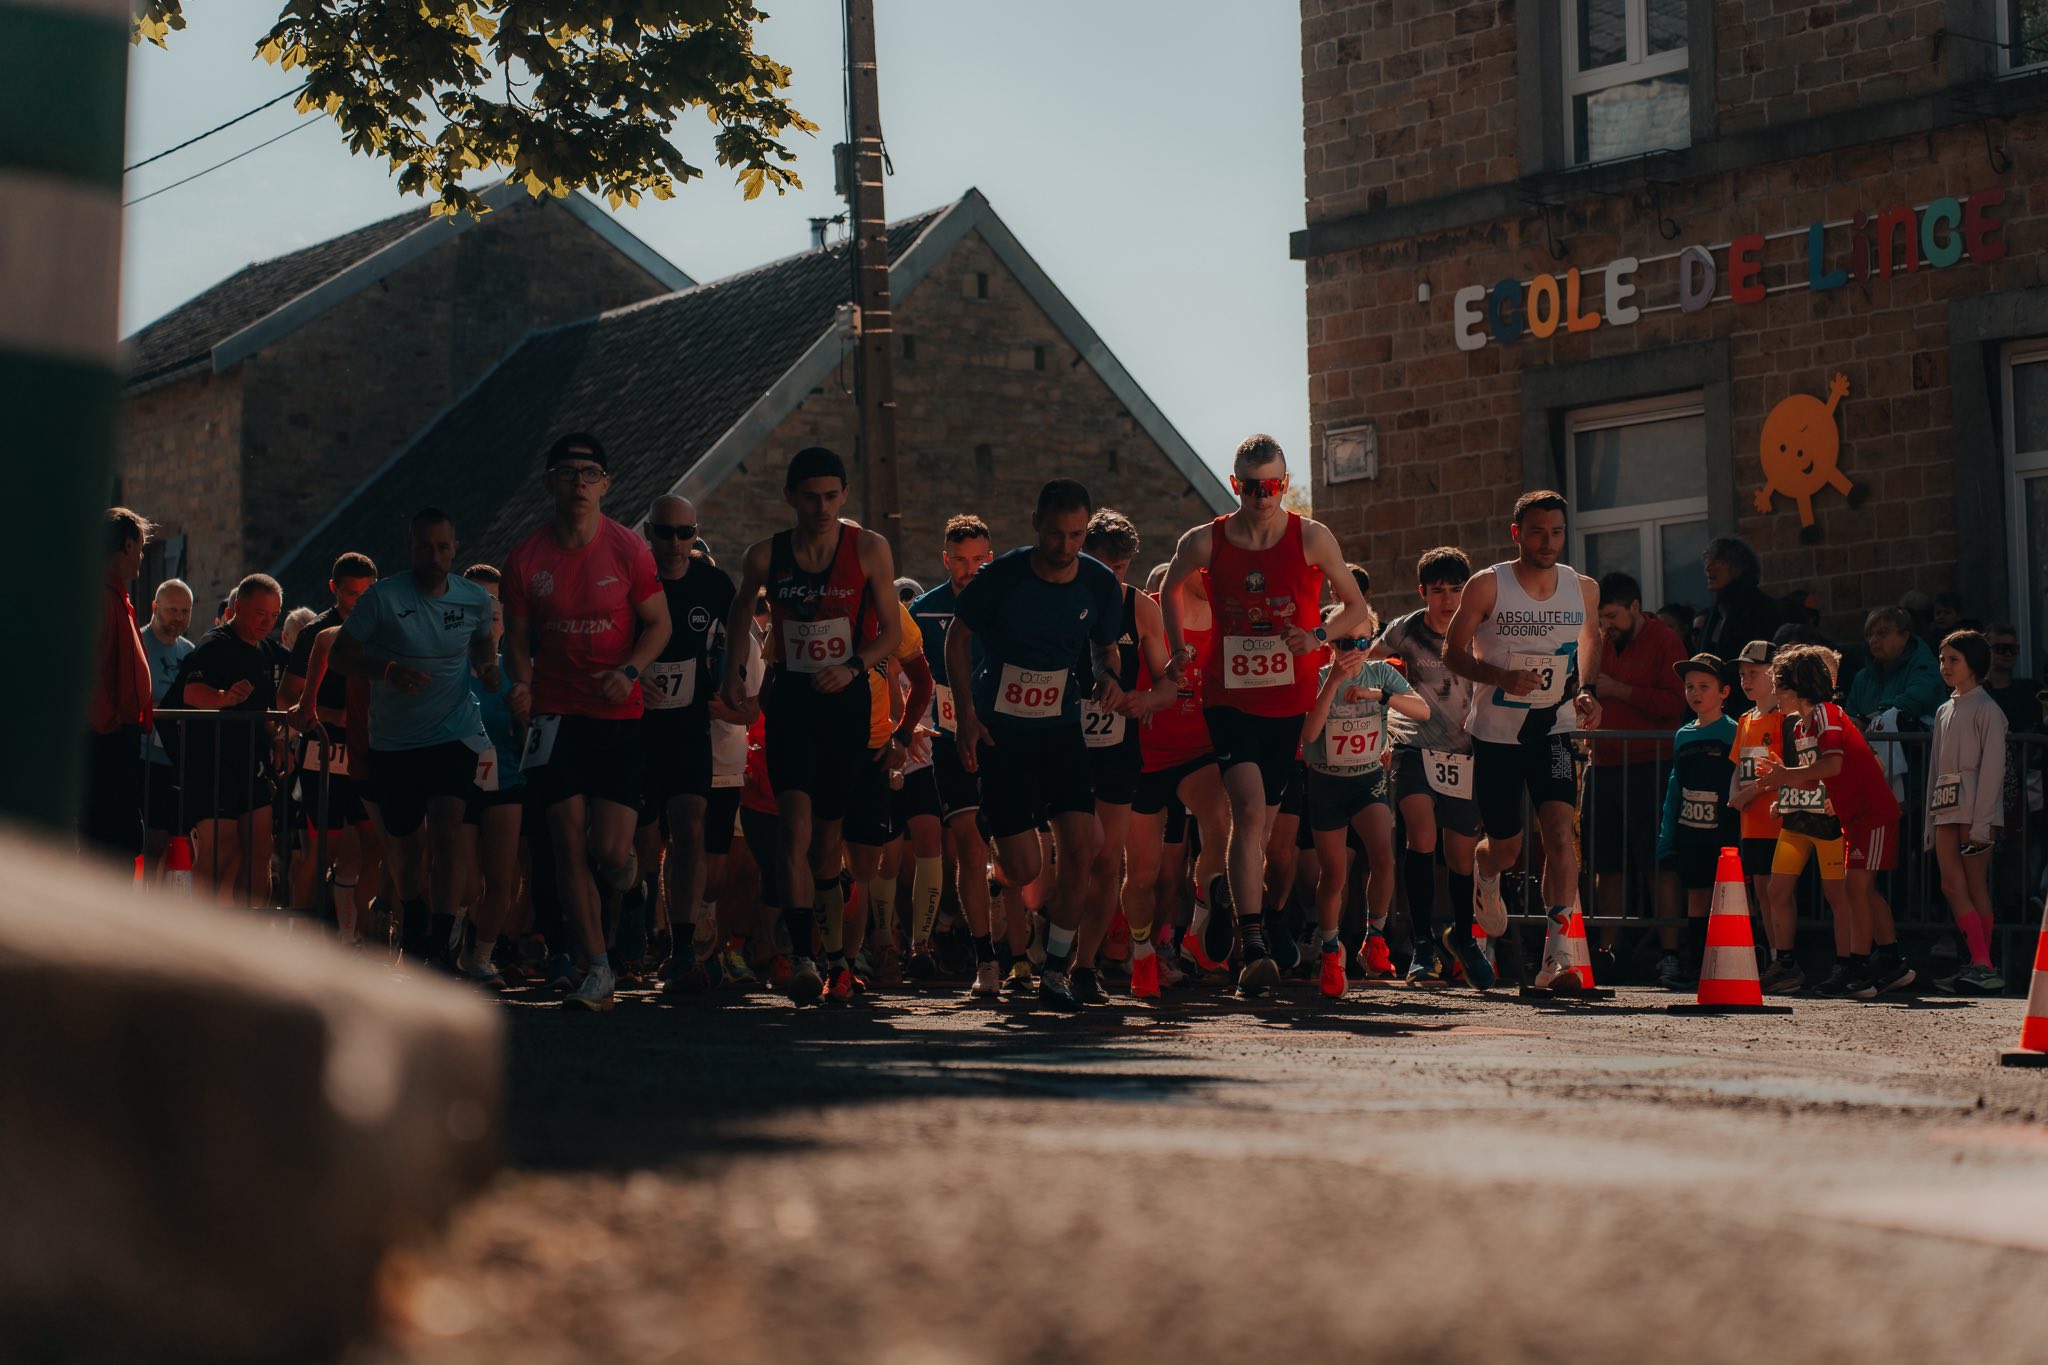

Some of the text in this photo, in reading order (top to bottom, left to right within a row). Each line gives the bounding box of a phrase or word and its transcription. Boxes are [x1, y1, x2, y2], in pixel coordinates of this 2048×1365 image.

[1454, 257, 1640, 351] ECOLE
[1679, 234, 1768, 313] DE
[778, 585, 807, 599] RFC
[1496, 625, 1548, 636] JOGGING
[790, 637, 846, 661] 769
[1232, 653, 1287, 675] 838
[1005, 683, 1059, 707] 809
[1085, 713, 1115, 734] 22
[1332, 731, 1379, 755] 797
[1347, 760, 1378, 774] NIKE
[1435, 763, 1459, 786] 35
[1780, 788, 1822, 806] 2832
[1931, 786, 1957, 807] 2805
[1680, 800, 1715, 821] 2803
